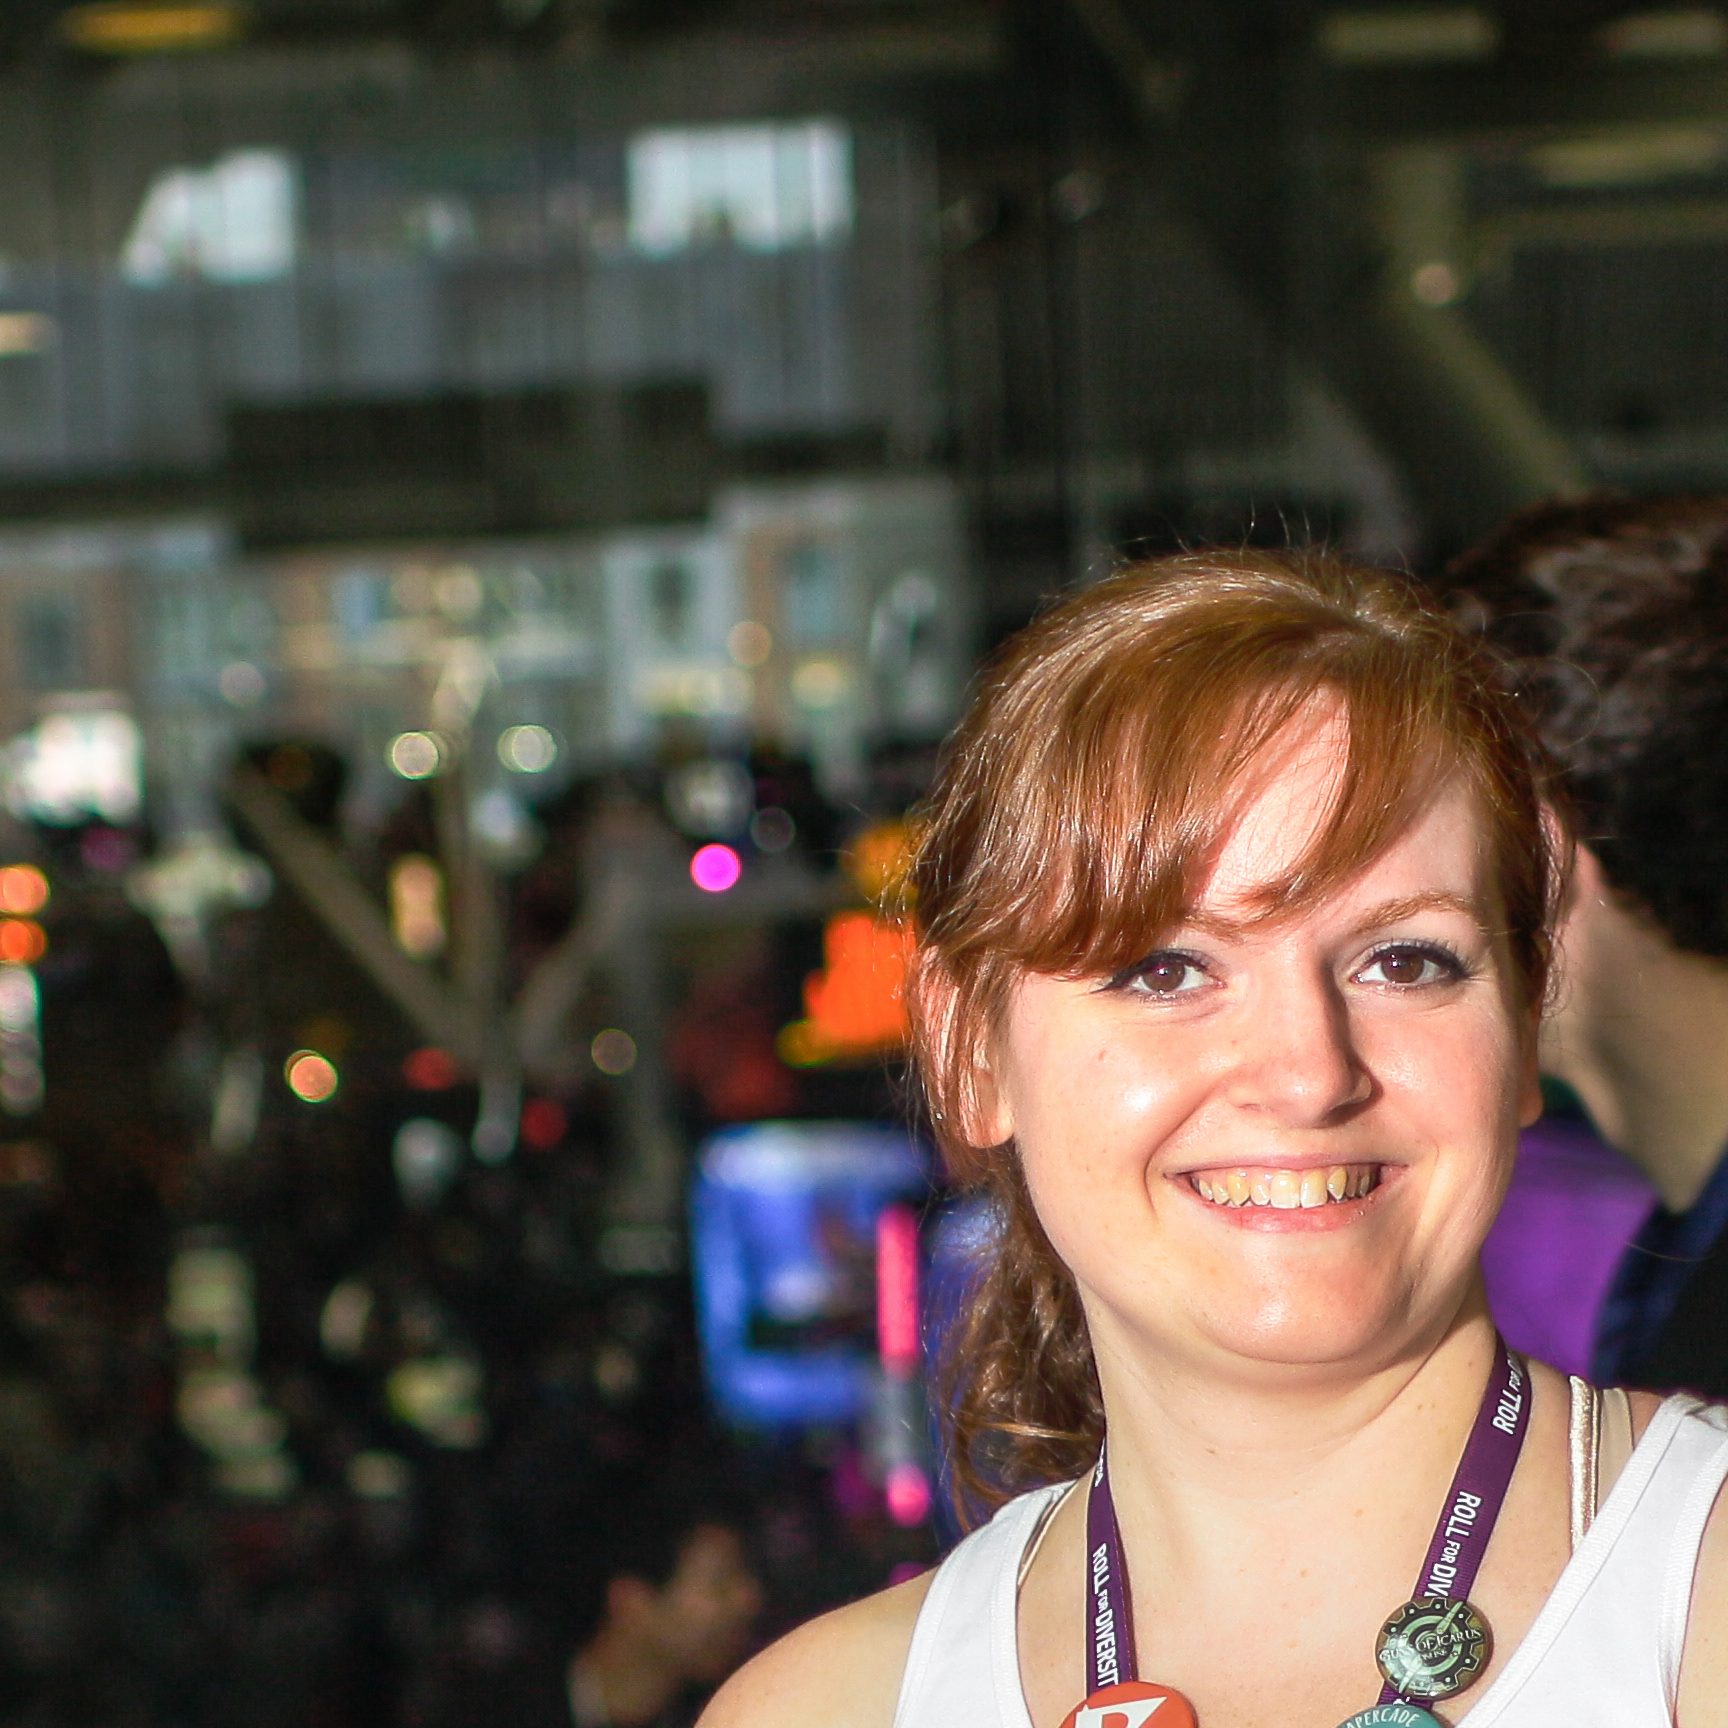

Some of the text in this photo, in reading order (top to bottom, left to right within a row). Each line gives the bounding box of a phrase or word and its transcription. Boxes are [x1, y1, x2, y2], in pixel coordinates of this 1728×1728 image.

[1493, 1389, 1522, 1435] ROLL
[1445, 1491, 1481, 1537] ROLL
[1093, 1542, 1110, 1594] ROLL
[1441, 1540, 1460, 1564] FOR
[1098, 1589, 1110, 1613] FOR
[1436, 1628, 1482, 1646] ICARUS
